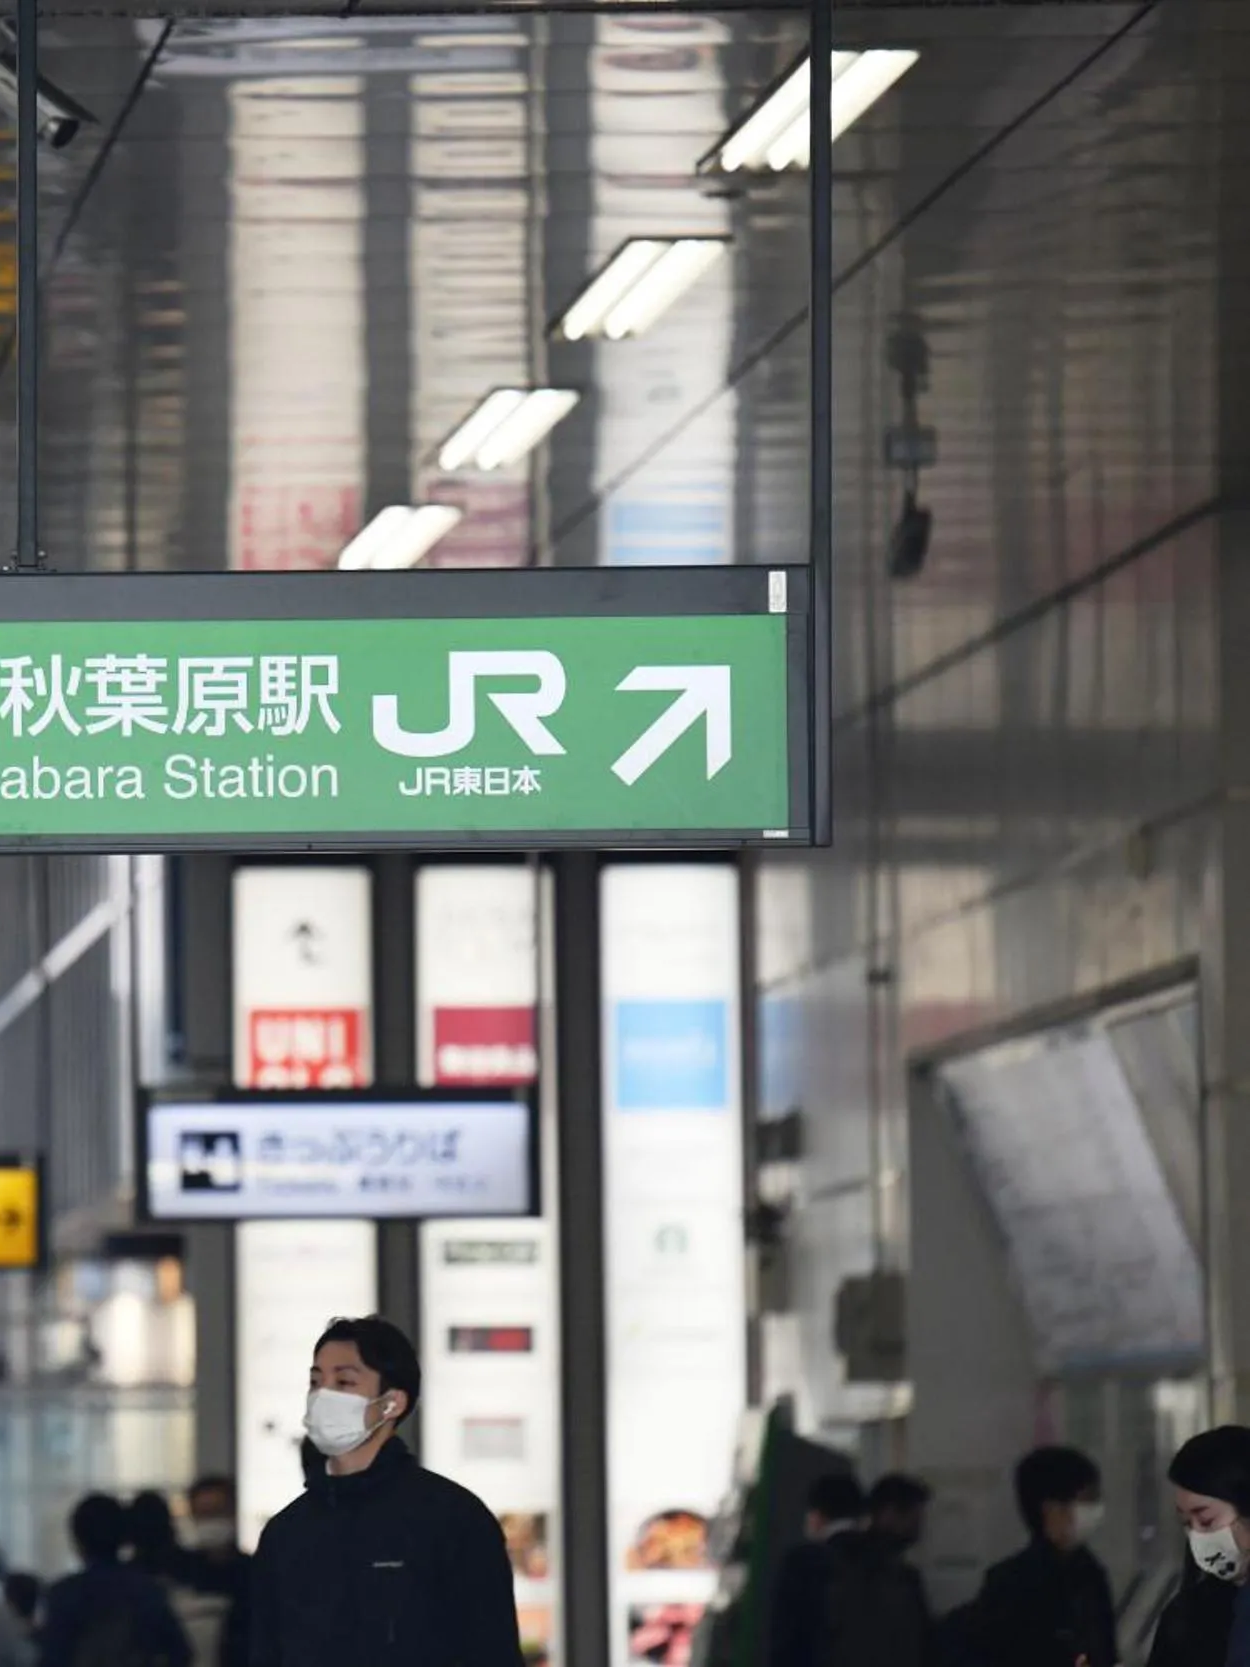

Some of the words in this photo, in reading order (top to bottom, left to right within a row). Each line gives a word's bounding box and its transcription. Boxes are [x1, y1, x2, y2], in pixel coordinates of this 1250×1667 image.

[372, 650, 567, 757] JR
[163, 753, 339, 801] Station
[398, 765, 542, 797] JR東日本
